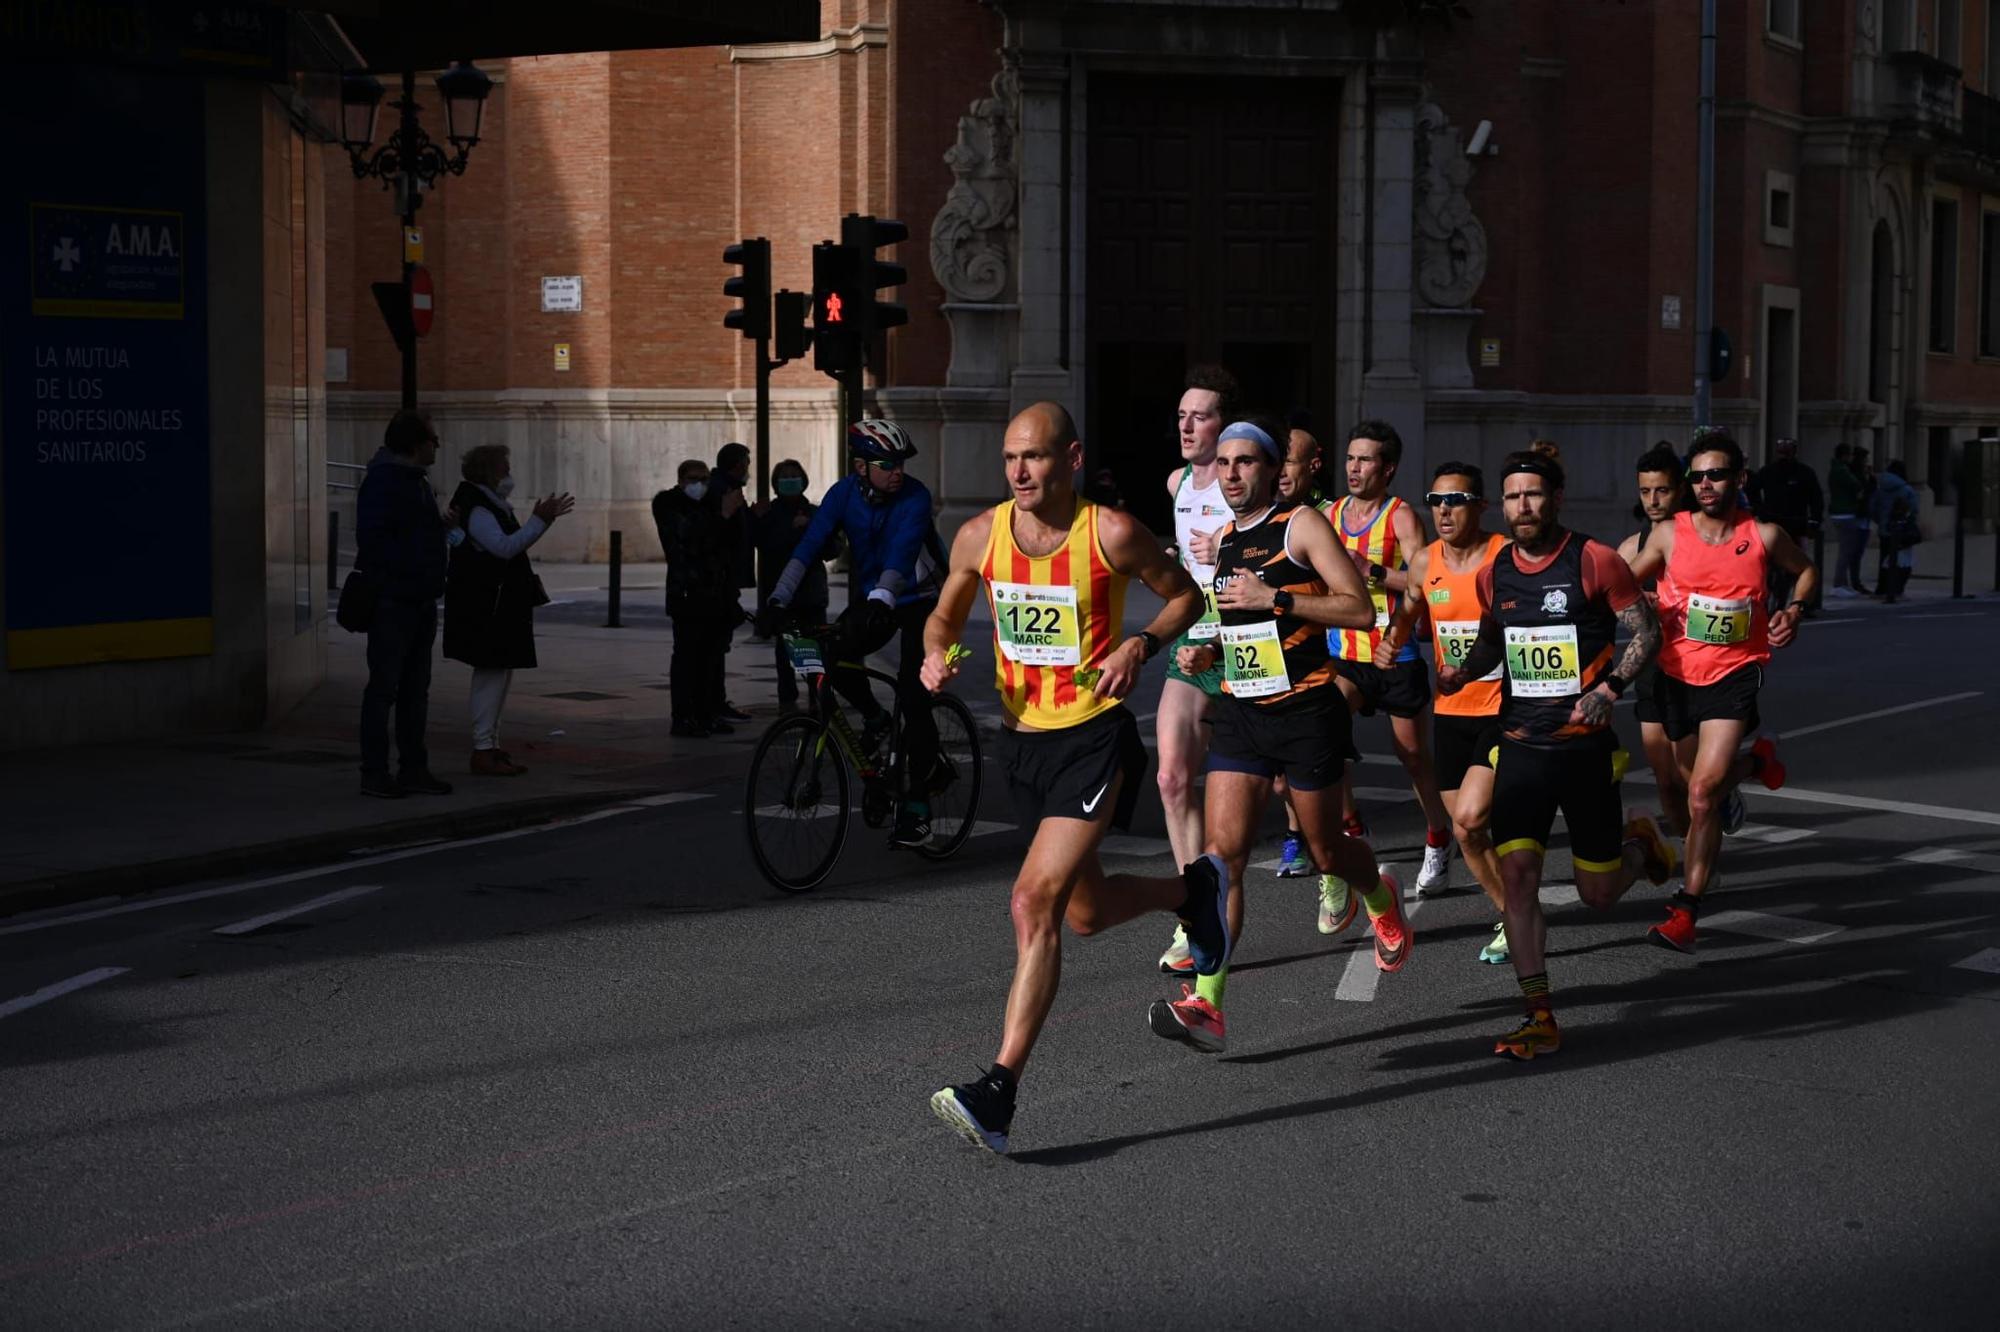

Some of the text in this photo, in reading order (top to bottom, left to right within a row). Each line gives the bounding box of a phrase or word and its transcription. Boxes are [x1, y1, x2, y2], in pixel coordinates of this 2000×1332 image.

[35, 345, 130, 368] LA MUTUA
[36, 377, 104, 400] DE LOS
[36, 408, 184, 431] PROFESIONALES
[37, 440, 148, 464] SANITARIOS
[1006, 606, 1061, 634] 122
[1706, 614, 1733, 634] 75
[1014, 634, 1053, 645] MARC
[1234, 645, 1260, 670] 62
[1517, 646, 1563, 671] 106
[1233, 668, 1269, 680] SIMONE
[1512, 669, 1577, 680] DANI PINEDA
